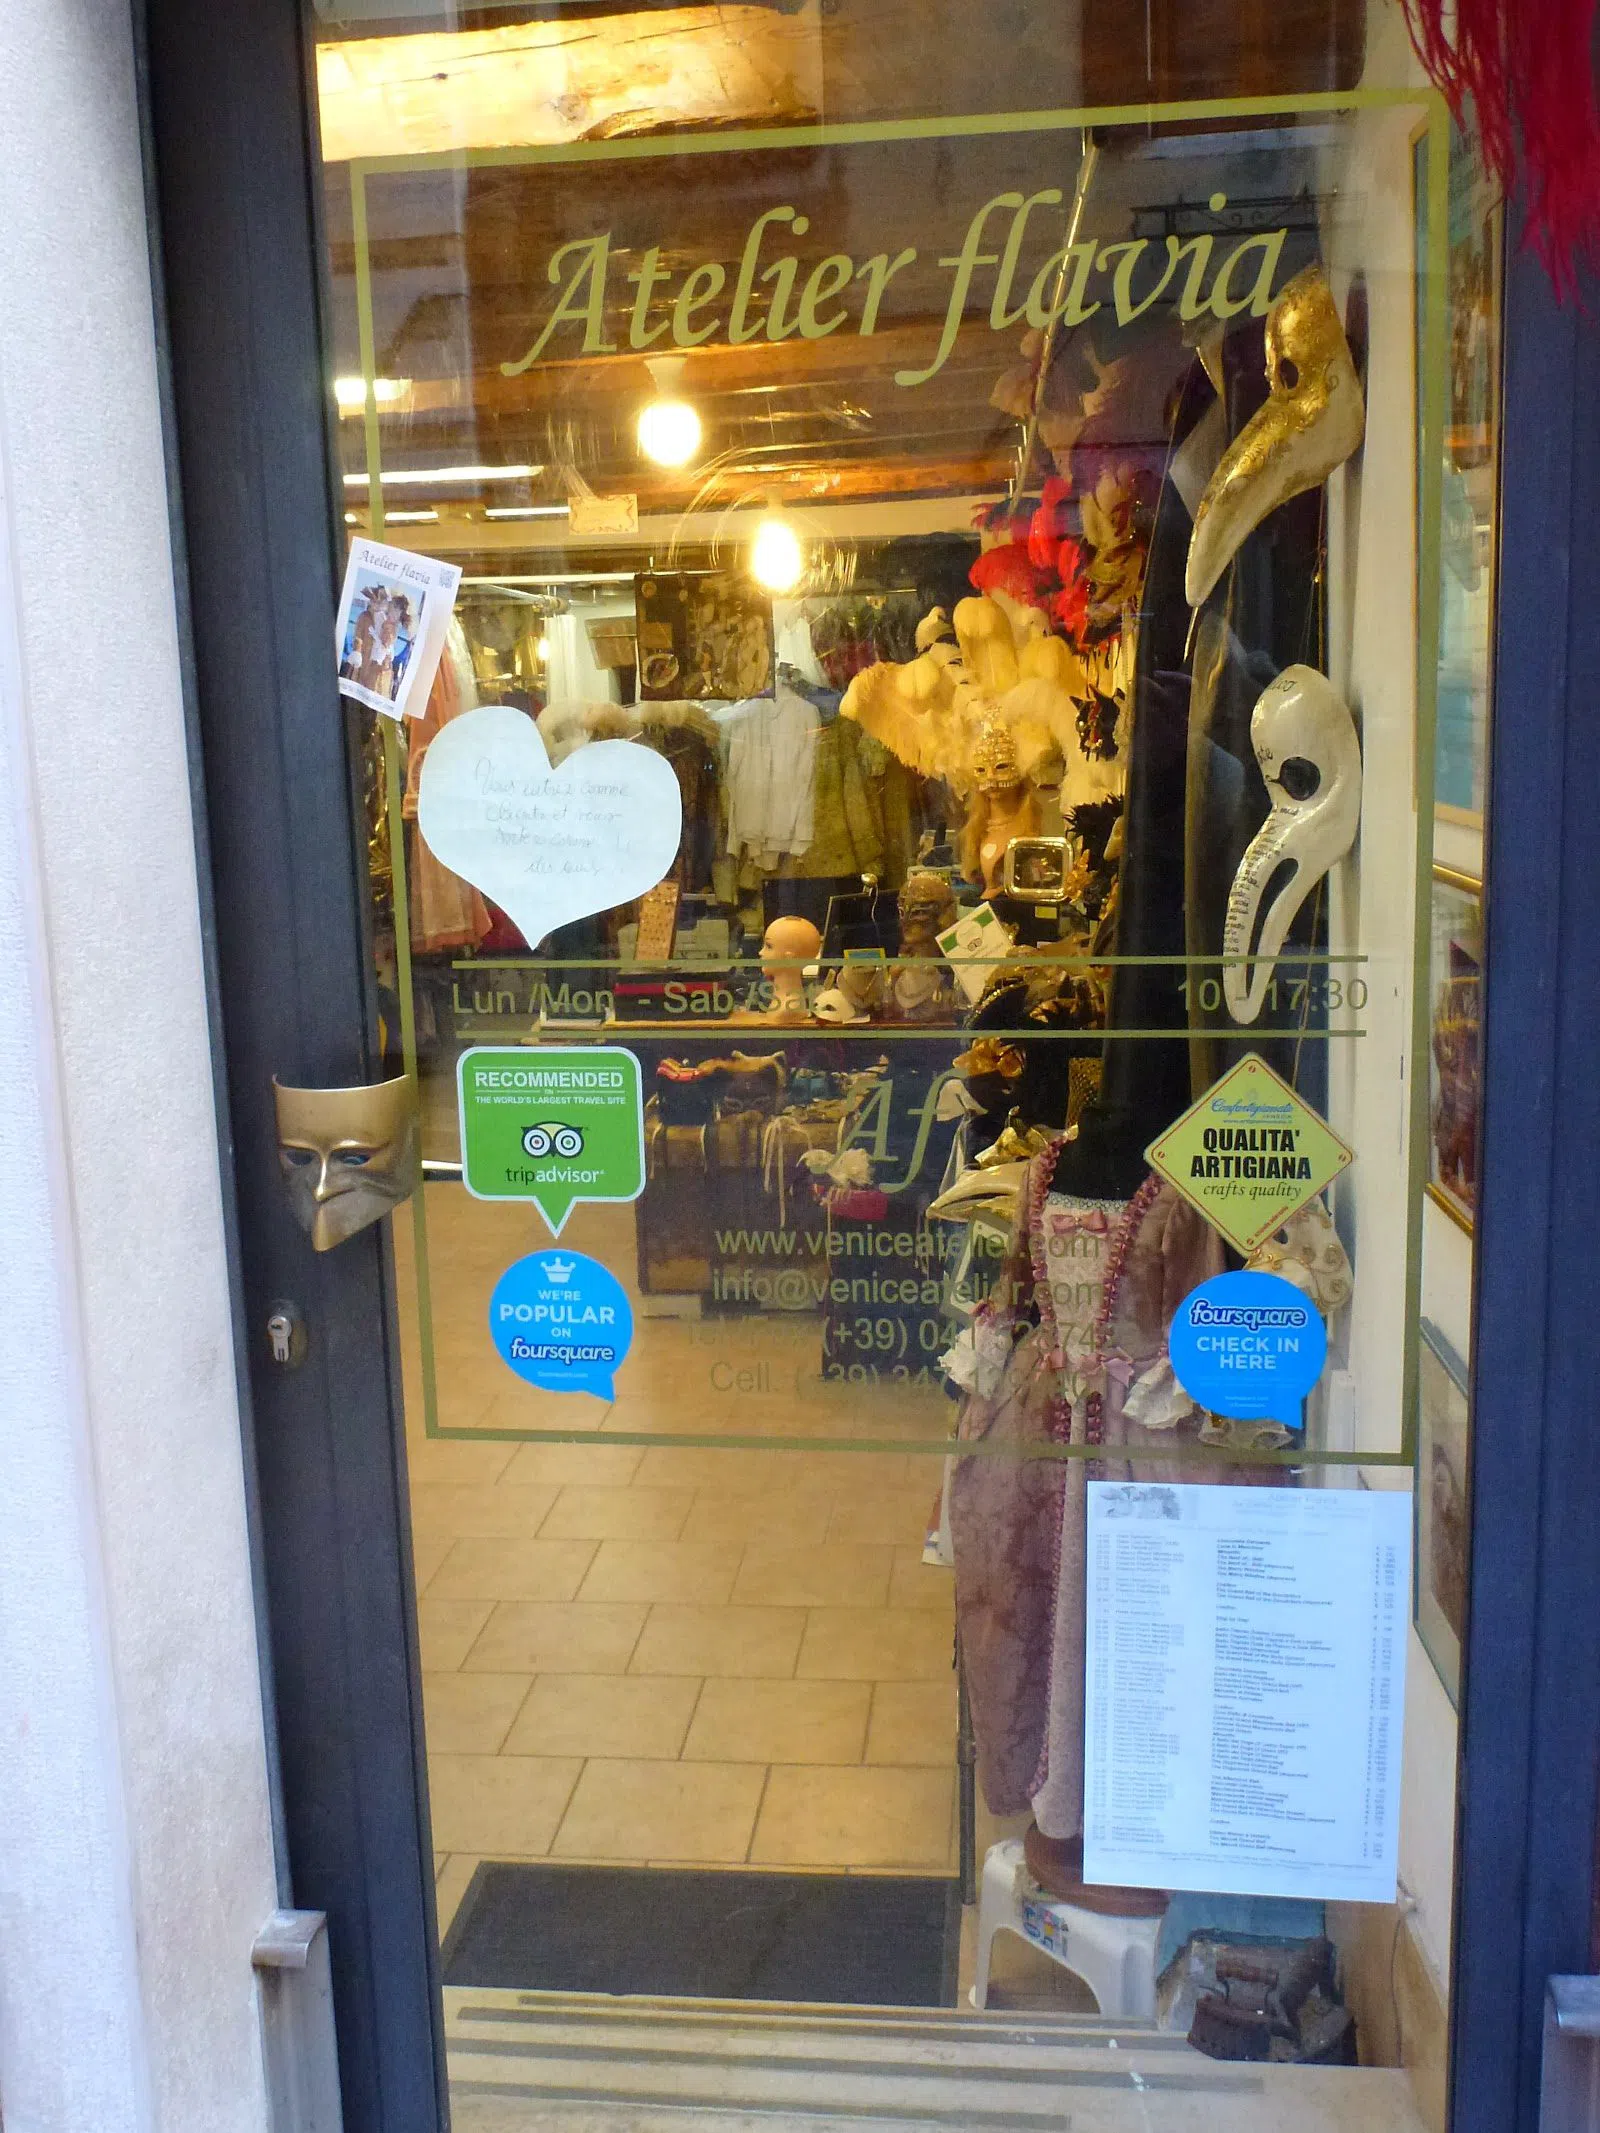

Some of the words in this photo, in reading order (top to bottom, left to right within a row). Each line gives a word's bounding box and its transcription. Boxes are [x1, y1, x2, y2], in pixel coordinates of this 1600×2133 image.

[501, 206, 916, 376] Atelier
[894, 191, 1288, 385] flavia
[358, 550, 399, 571] Atelier
[398, 562, 431, 585] flavia
[453, 983, 516, 1014] Lun
[1178, 978, 1221, 1011] 10
[1265, 977, 1368, 1011] 17:30
[475, 1071, 623, 1087] RECOMMENDED
[475, 1096, 491, 1104] THE
[494, 1096, 532, 1104] WORLD'S
[533, 1096, 571, 1104] LARGEST
[1203, 1128, 1300, 1153] QUALITA'
[506, 1166, 600, 1185] tripadvisor
[1190, 1155, 1311, 1179] ARTIGIANA
[1203, 1181, 1246, 1200] crafts
[1249, 1181, 1302, 1201] quality
[538, 1290, 581, 1301] WE'RE
[500, 1304, 615, 1325] POPULAR
[1190, 1300, 1307, 1330] foursquare
[551, 1327, 571, 1338] ON
[822, 1316, 908, 1358] (+39)
[511, 1338, 615, 1364] foursquare
[1196, 1336, 1270, 1352] CHECK
[1277, 1337, 1300, 1353] IN
[1219, 1354, 1277, 1370] HERE
